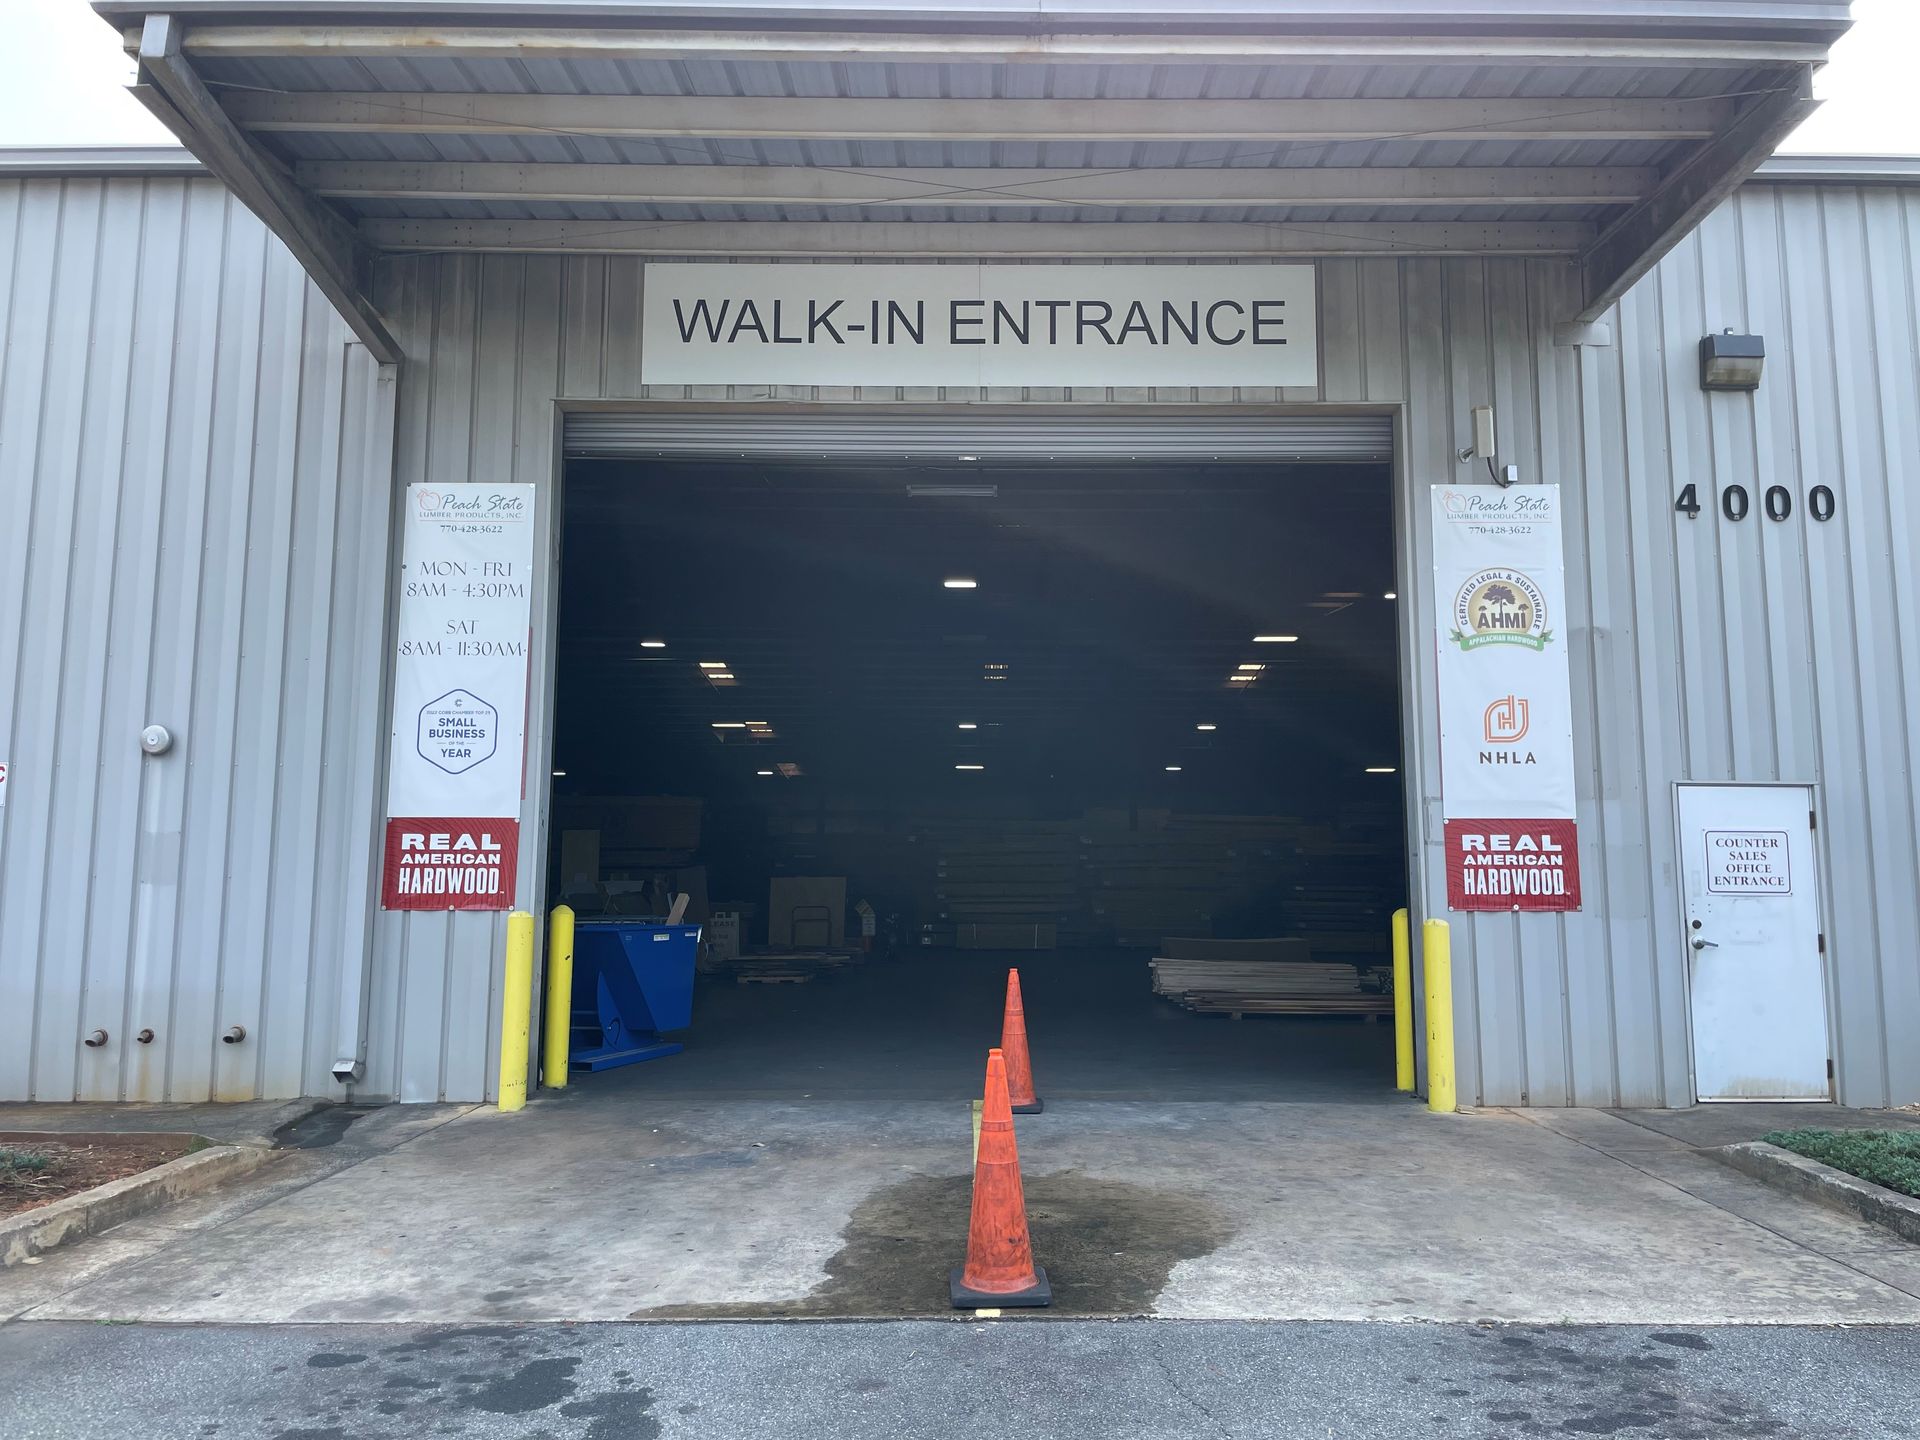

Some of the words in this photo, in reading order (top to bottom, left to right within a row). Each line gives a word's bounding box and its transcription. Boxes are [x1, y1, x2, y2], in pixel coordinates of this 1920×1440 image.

[673, 299, 924, 345] WALK-IN
[950, 299, 1287, 345] ENTRANCE
[442, 494, 482, 510] Peach
[487, 494, 524, 512] State
[1467, 495, 1508, 512] Peach
[1514, 495, 1550, 513] State
[1675, 484, 1835, 522] 4000
[419, 511, 452, 519] LUMBER
[454, 512, 504, 520] PRODUCTS,
[1482, 513, 1532, 521] PRODUCTS,
[440, 525, 503, 533] 770-428-3622
[1468, 526, 1532, 535] 770-428-3622
[420, 561, 467, 577] MON
[483, 562, 512, 577] FRI
[406, 582, 446, 597] 8AM
[462, 582, 524, 598] 4:30PM
[1459, 582, 1476, 625] CERTIFIED
[1476, 572, 1503, 585] LEGAL
[1505, 573, 1512, 581] &
[1514, 577, 1543, 630] SUSTAINABLE
[446, 619, 479, 635] SAT
[1477, 612, 1527, 629] AHMI
[401, 641, 441, 656] 8AM
[458, 641, 522, 657] 11:30AM
[438, 717, 477, 727] SMALL
[429, 728, 485, 738] BUSINESS
[441, 748, 471, 758] YEAR
[1479, 751, 1537, 764] NHLA
[401, 834, 501, 850] REAL
[1461, 835, 1562, 852] REAL
[1715, 838, 1779, 848] COUNTER
[400, 853, 501, 865] AMERICAN
[1463, 854, 1563, 866] AMERICAN
[1729, 851, 1767, 861] SALES
[1726, 864, 1772, 873] OFFICE
[398, 867, 500, 895] HARDWOOD
[1464, 868, 1565, 896] HARDWOOD
[1714, 876, 1785, 886] ENTRANCE
